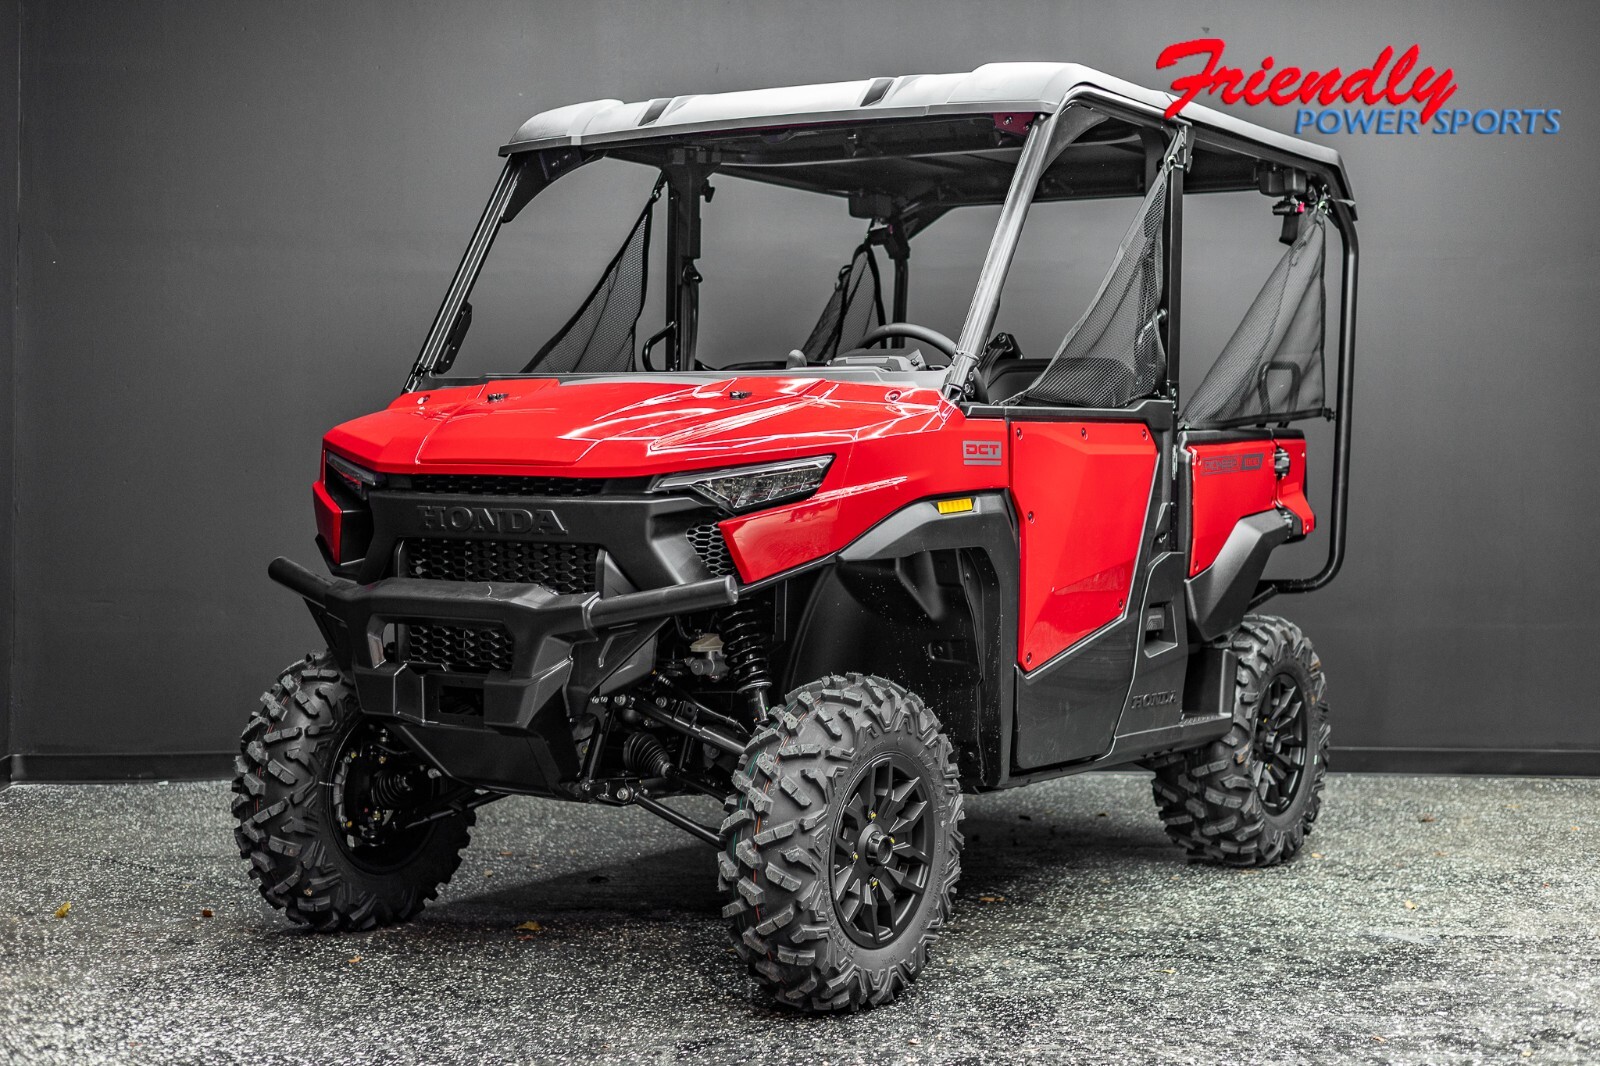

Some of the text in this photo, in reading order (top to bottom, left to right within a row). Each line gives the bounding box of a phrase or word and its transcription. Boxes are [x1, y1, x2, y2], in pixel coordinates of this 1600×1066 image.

[965, 444, 999, 455] DCT
[416, 505, 569, 535] HONDA
[1131, 690, 1176, 708] HONDA
